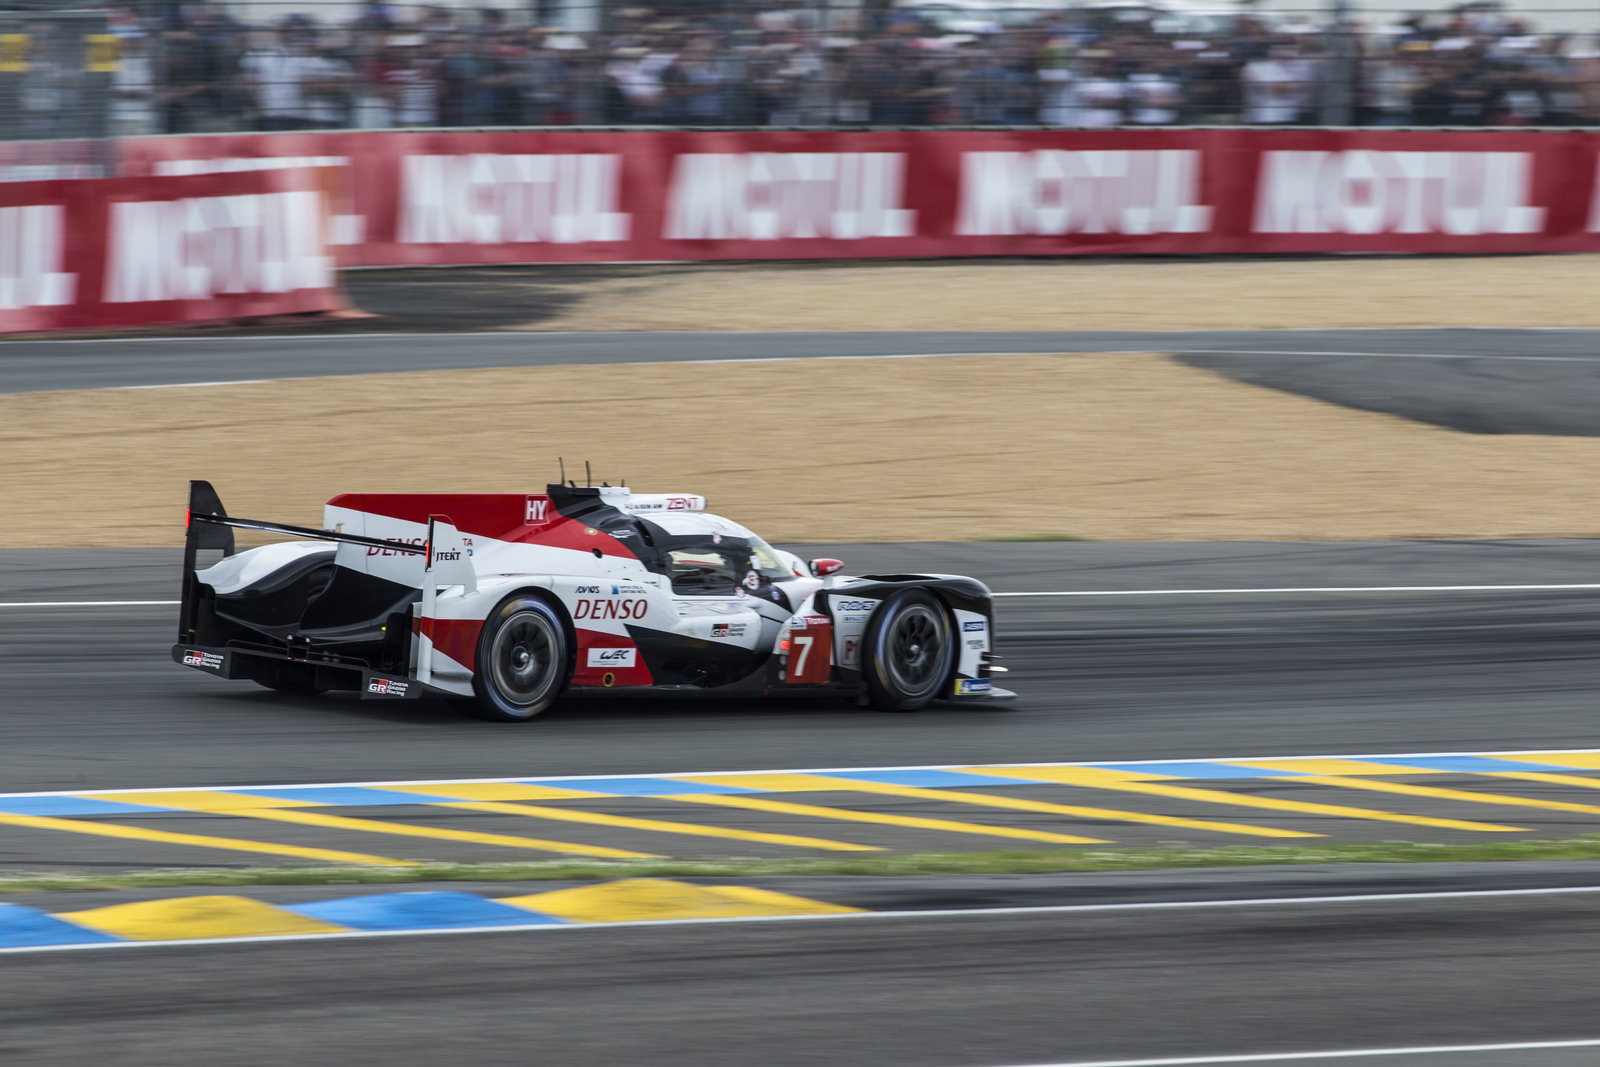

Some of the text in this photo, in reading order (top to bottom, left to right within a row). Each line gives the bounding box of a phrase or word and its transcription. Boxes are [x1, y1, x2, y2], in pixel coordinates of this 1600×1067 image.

[396, 153, 632, 243] MOTUL
[662, 152, 917, 239] MOTUL
[954, 149, 1214, 235] MOTUL
[1251, 150, 1548, 234] MOTUL
[103, 190, 336, 303] MOTUL
[526, 500, 548, 520] HY
[436, 549, 461, 562] JTEKT
[574, 599, 648, 620] DENSO
[183, 655, 202, 665] GR
[600, 650, 630, 660] WEC
[794, 637, 814, 676] 7
[369, 683, 387, 693] GR
